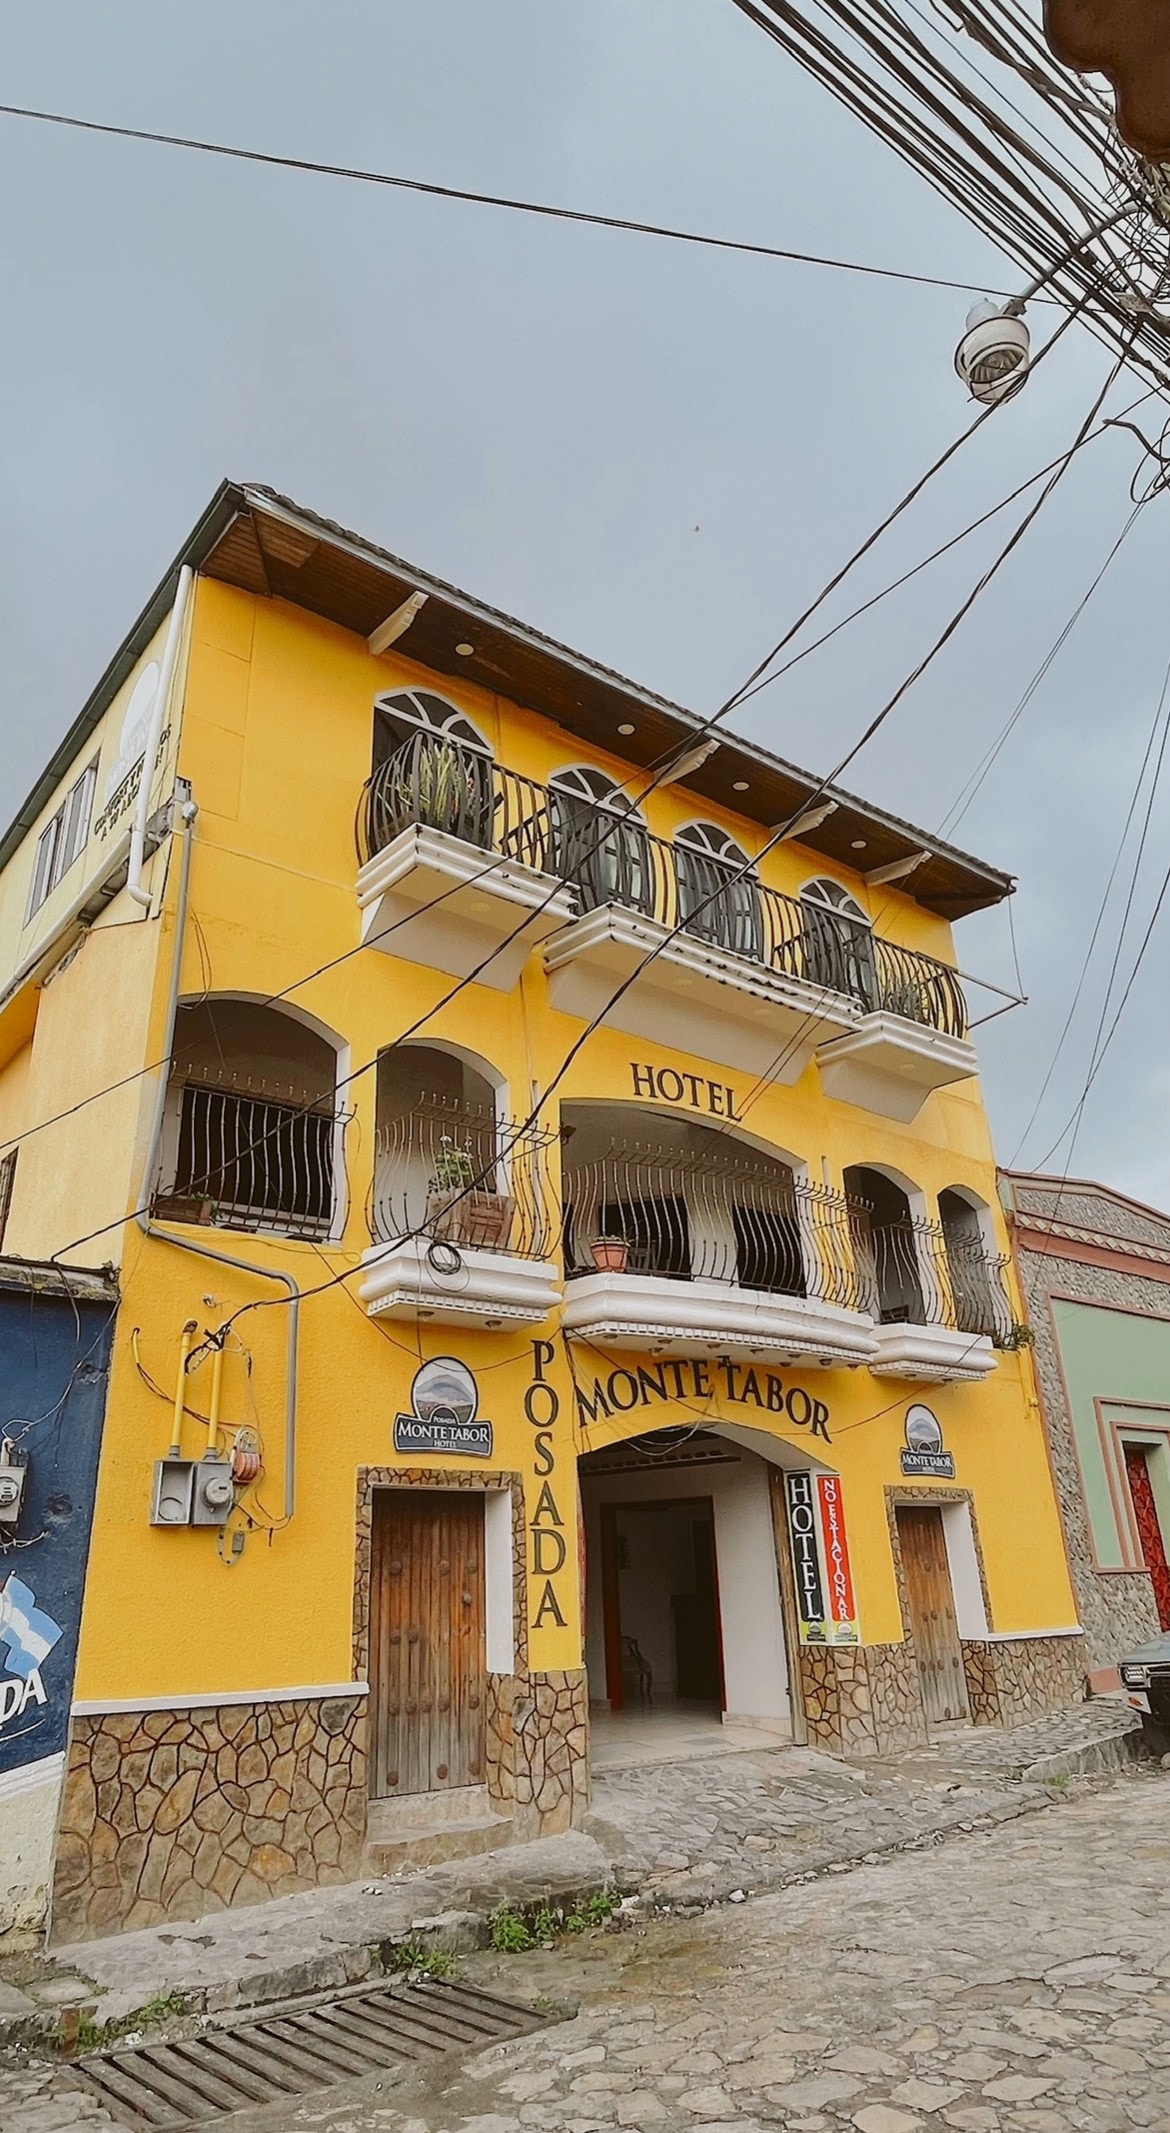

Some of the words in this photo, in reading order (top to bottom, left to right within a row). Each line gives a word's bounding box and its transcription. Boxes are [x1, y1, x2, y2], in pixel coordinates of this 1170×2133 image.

[629, 1062, 742, 1121] HOTEL
[398, 1421, 447, 1439] MONTE
[448, 1427, 489, 1442] TABOR
[574, 1359, 711, 1427] MONTE
[717, 1361, 832, 1444] TABOR
[434, 1440, 456, 1448] HOTEL
[524, 1339, 568, 1629] POSADA
[824, 1479, 837, 1502] NO
[789, 1477, 823, 1620] HOTEL
[828, 1504, 849, 1620] ESTACIONAR
